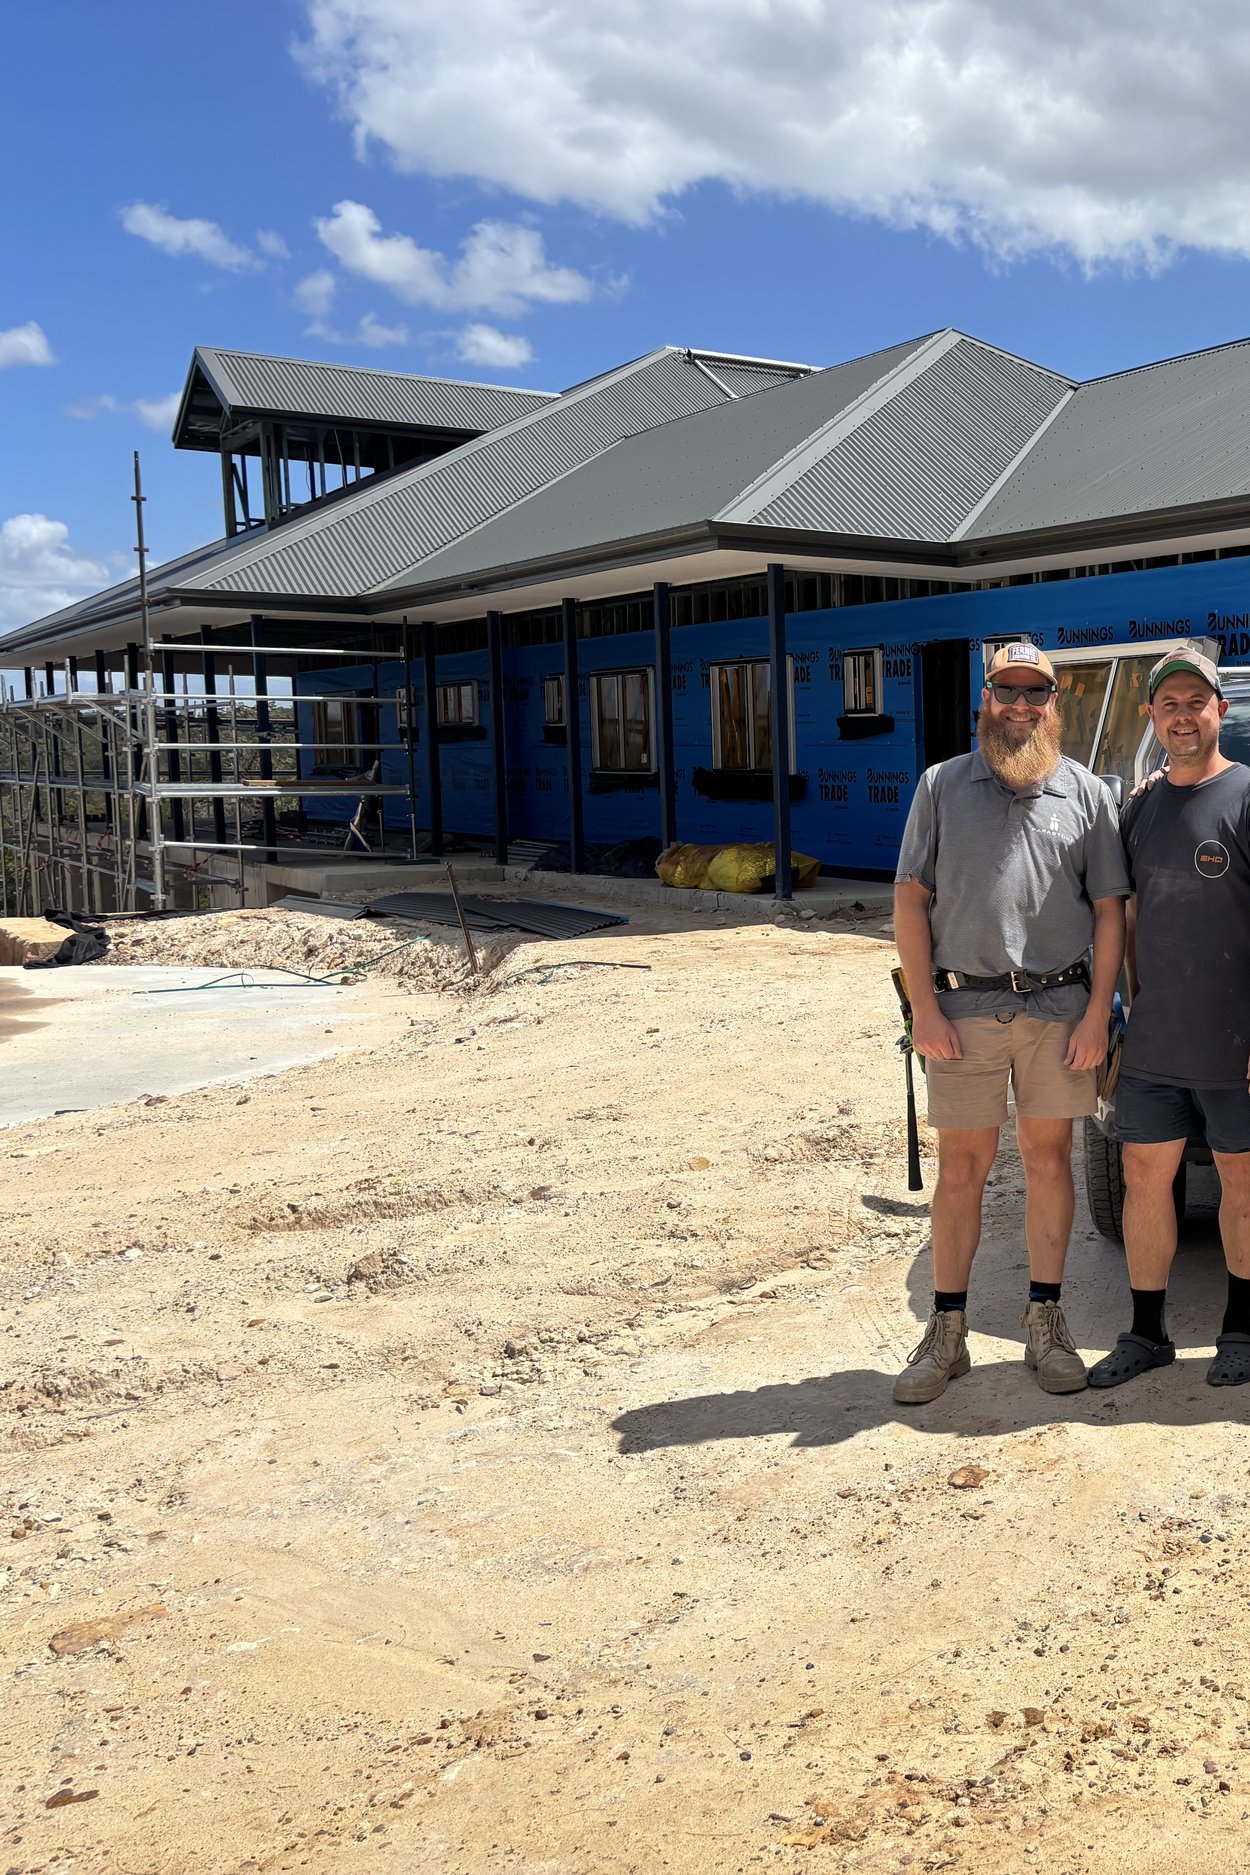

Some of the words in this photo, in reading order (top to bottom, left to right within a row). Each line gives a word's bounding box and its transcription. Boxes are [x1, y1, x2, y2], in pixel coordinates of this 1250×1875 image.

[1057, 627, 1114, 645] BUNNINGS
[1129, 619, 1191, 639] BUNNINGS
[794, 666, 811, 683] ADE
[817, 768, 857, 783] BUNNINGS
[866, 768, 909, 784] BUNNINGS
[819, 784, 848, 802] TRADE
[867, 785, 899, 804] TRADE
